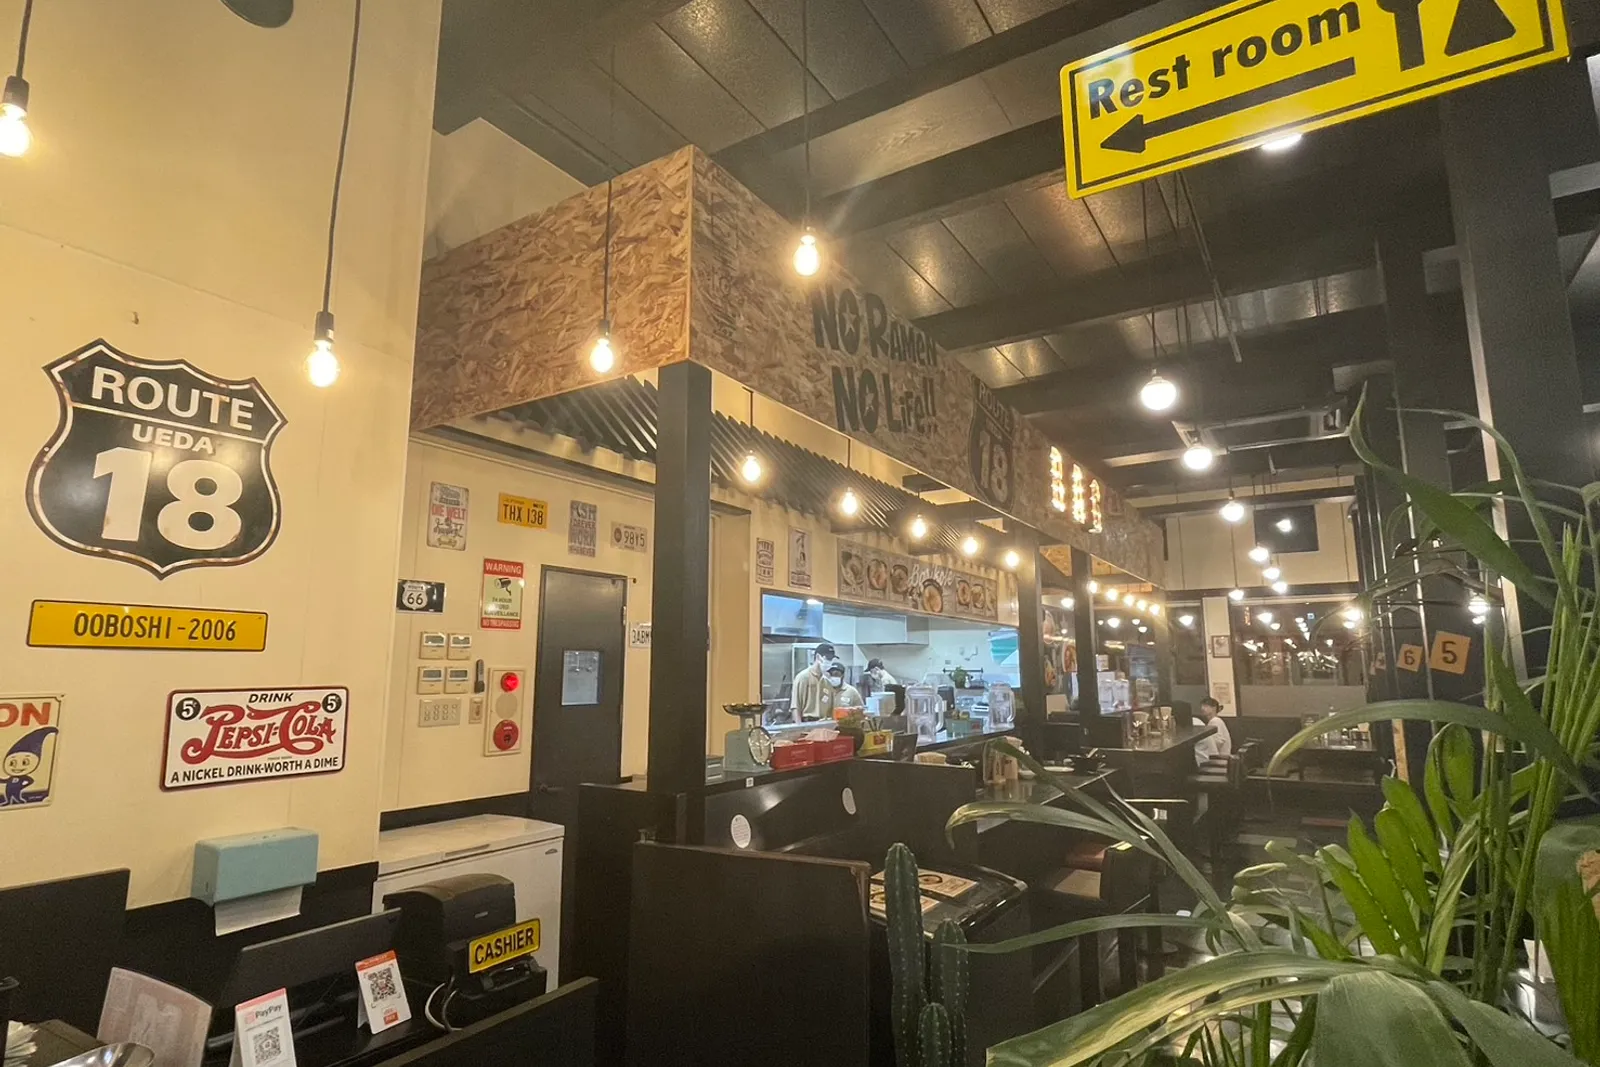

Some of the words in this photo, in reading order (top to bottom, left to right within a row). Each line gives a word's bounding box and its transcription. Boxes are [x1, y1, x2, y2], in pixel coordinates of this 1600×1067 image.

[1088, 55, 1191, 119] Rest
[1213, 1, 1362, 78] room
[91, 366, 255, 431] ROUTE
[979, 382, 1012, 431] ROUTE
[132, 423, 216, 454] UEDA
[979, 430, 1008, 505] 18
[93, 447, 243, 550] 18
[503, 503, 523, 522] THX
[527, 507, 544, 525] 138
[485, 562, 522, 574] WARNING
[407, 592, 424, 606] 66
[1404, 651, 1416, 666] 6
[1442, 641, 1458, 665] 5
[248, 693, 294, 704] DRINK
[171, 771, 180, 784] A
[182, 767, 225, 781] NICKEL
[227, 760, 301, 777] DRINK-WORTH
[304, 759, 312, 769] A
[314, 757, 339, 769] DIME
[475, 927, 535, 965] CASHIER
[255, 1004, 282, 1019] PayPay
